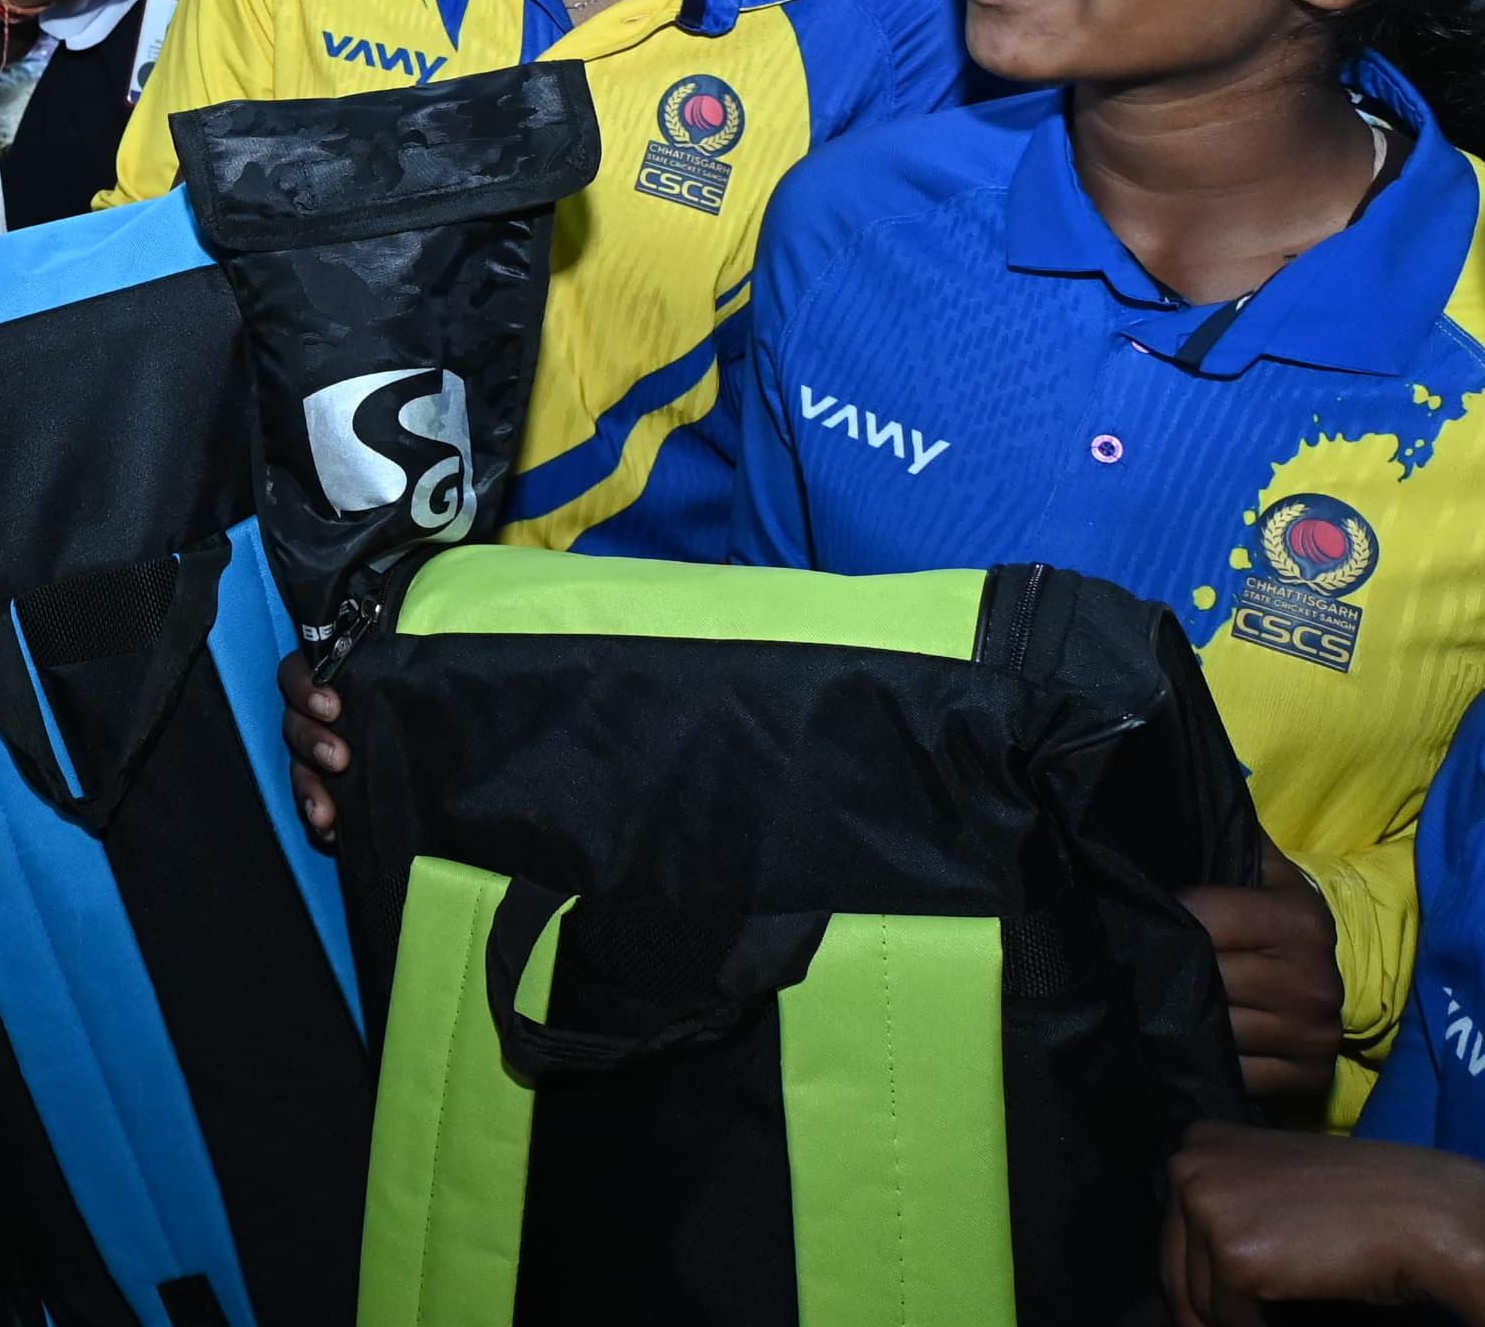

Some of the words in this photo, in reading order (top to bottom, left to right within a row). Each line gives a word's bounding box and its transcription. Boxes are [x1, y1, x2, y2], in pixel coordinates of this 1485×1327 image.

[649, 143, 731, 175] CHHATTISGARH
[639, 167, 724, 208] CSCS
[1244, 589, 1272, 604] STATE
[1273, 598, 1317, 619] CRICKET
[1319, 613, 1356, 632] SANGH
[1246, 577, 1359, 621] CHHATTISGARH
[1235, 608, 1352, 664] CSCS
